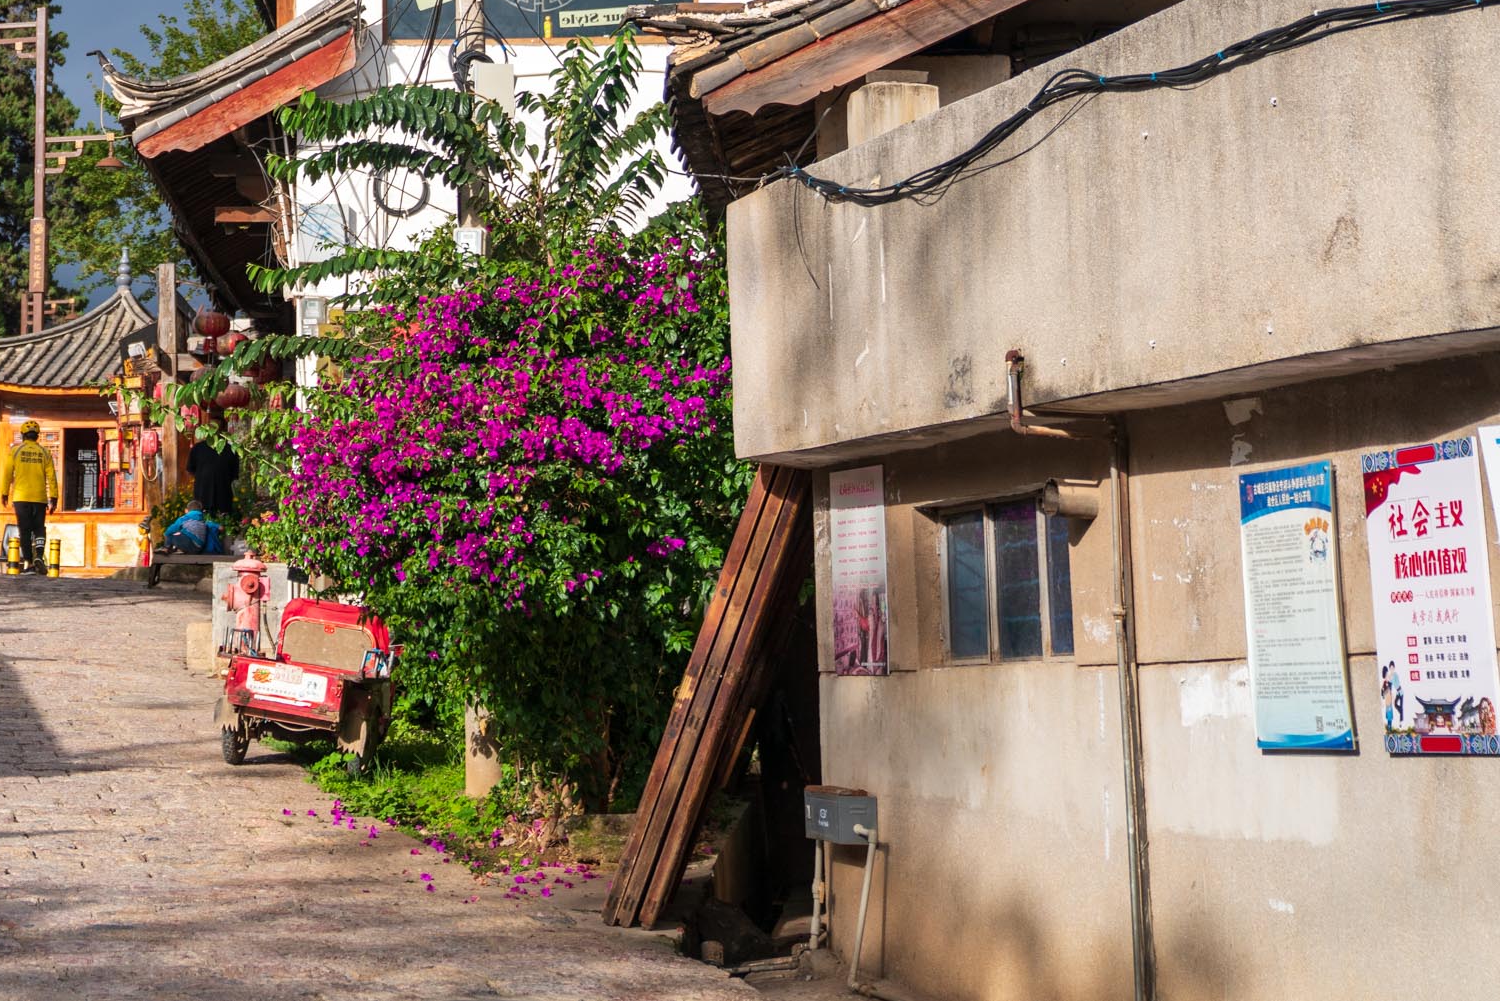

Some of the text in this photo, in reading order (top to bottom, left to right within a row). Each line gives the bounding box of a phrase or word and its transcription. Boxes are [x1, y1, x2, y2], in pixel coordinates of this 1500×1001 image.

[1389, 500, 1463, 539] 社会主义
[1395, 547, 1467, 579] 核心价值观
